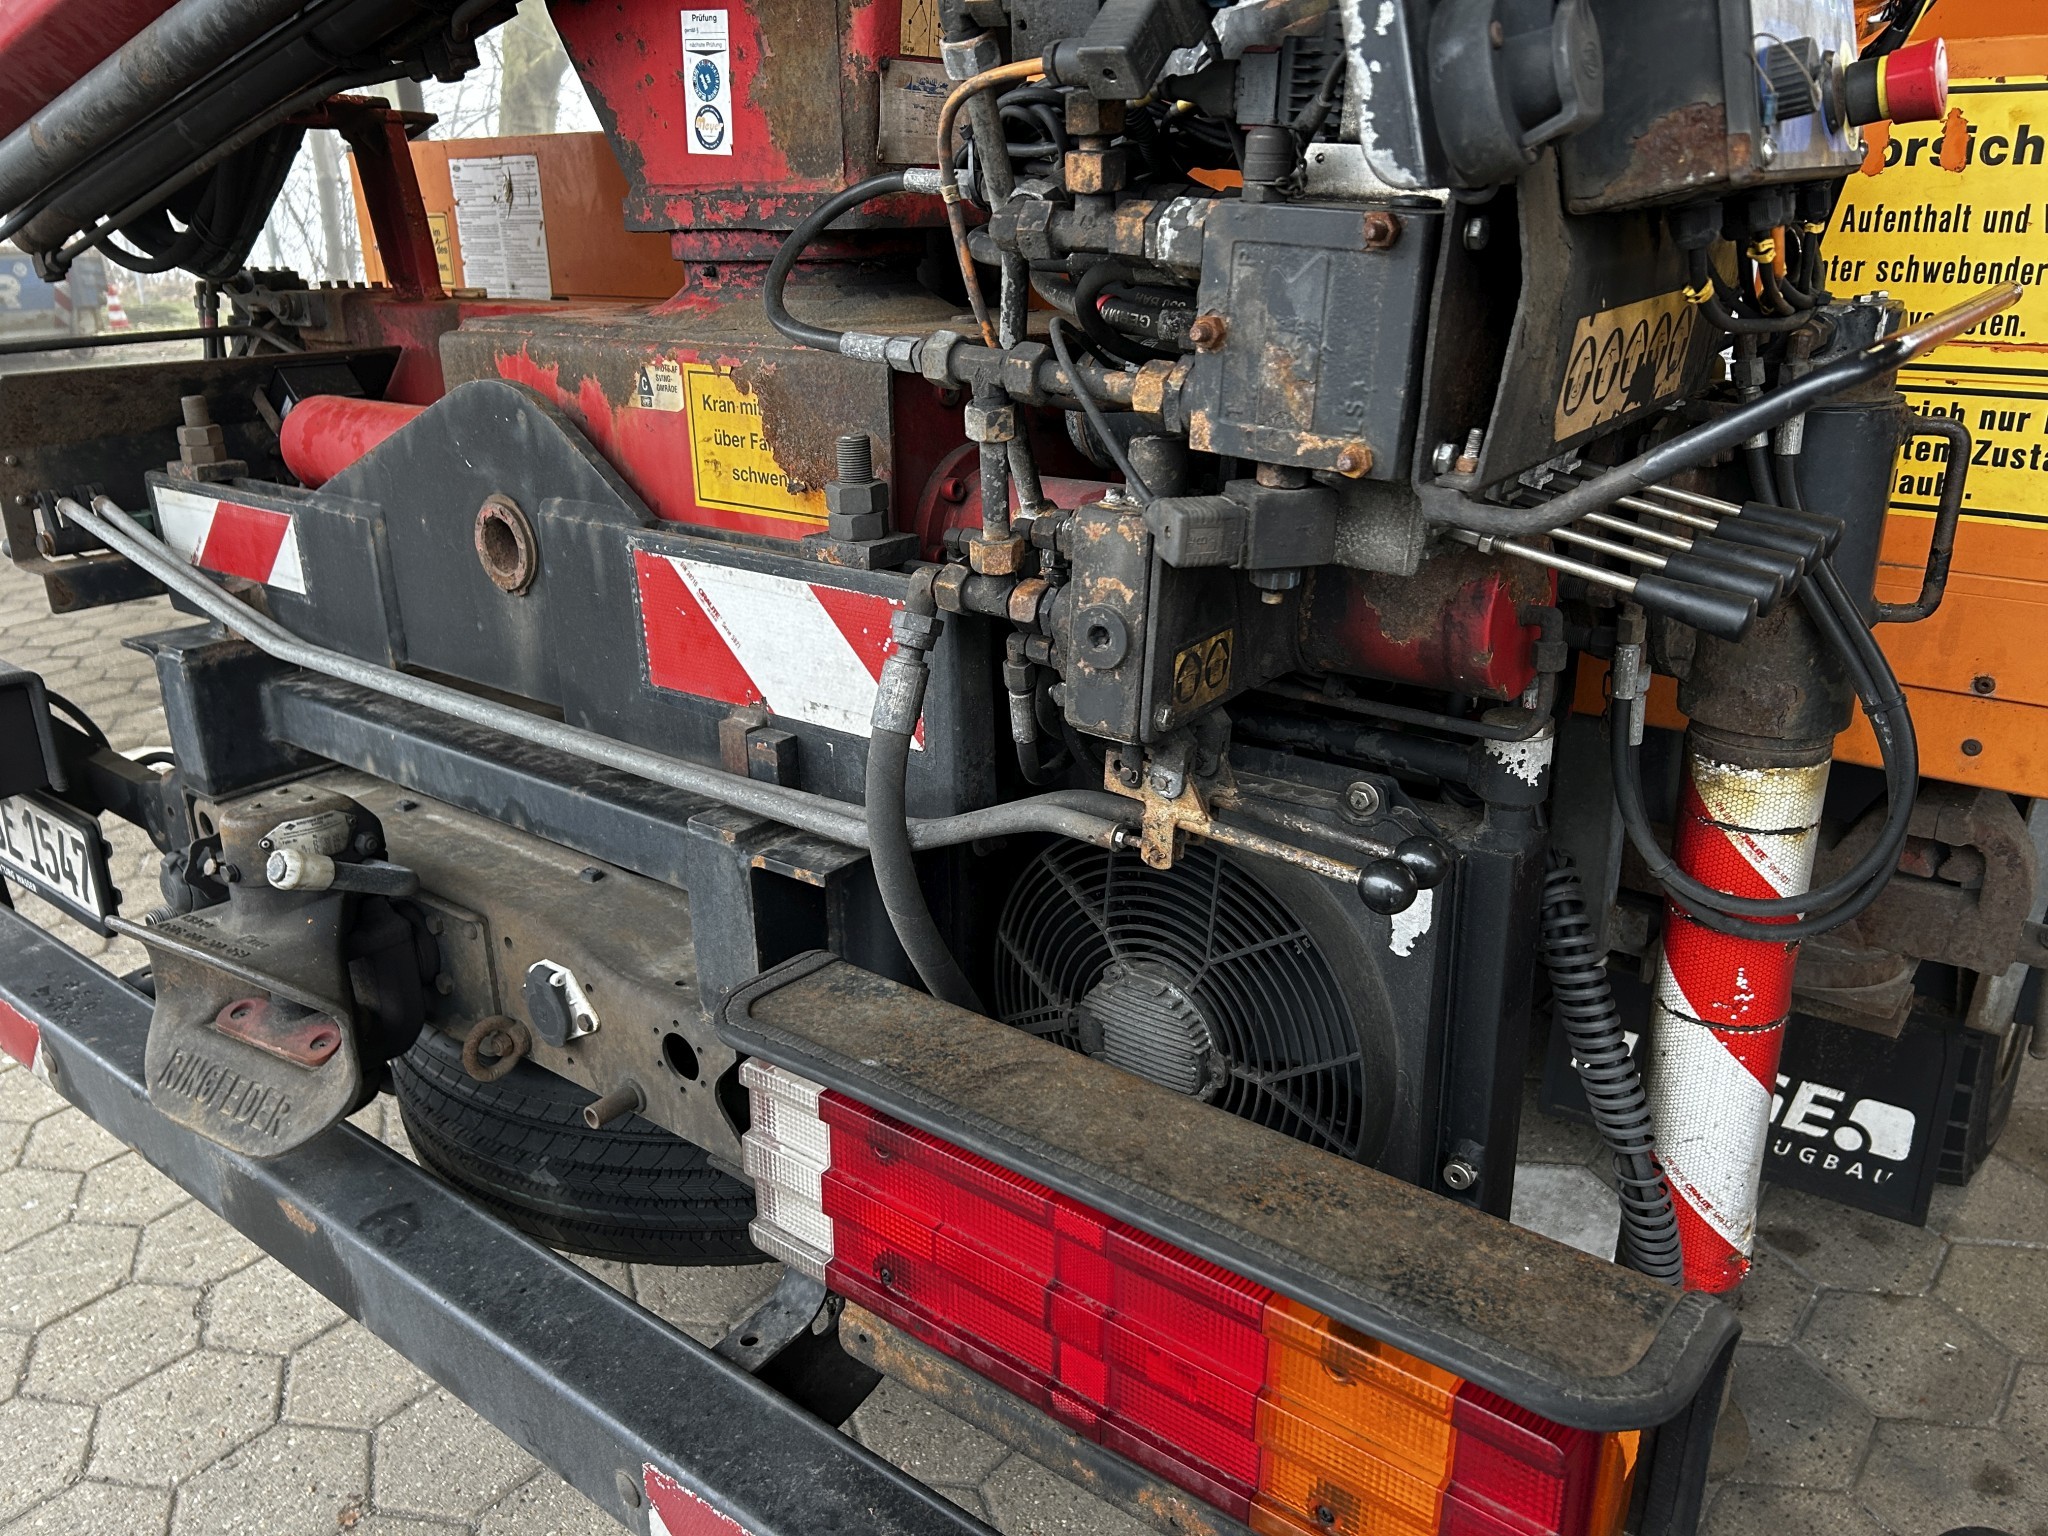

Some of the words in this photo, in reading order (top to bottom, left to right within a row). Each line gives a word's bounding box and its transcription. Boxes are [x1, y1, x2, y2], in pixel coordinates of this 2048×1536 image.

[691, 14, 718, 24] Prüfung
[1840, 203, 1972, 233] Aufenthalt
[1983, 203, 2031, 234] und
[702, 394, 736, 414] Kran
[740, 398, 763, 416] mit
[1978, 409, 2032, 433] nur
[714, 428, 746, 450] über
[732, 466, 788, 488] schwen
[22, 809, 91, 905] 1547
